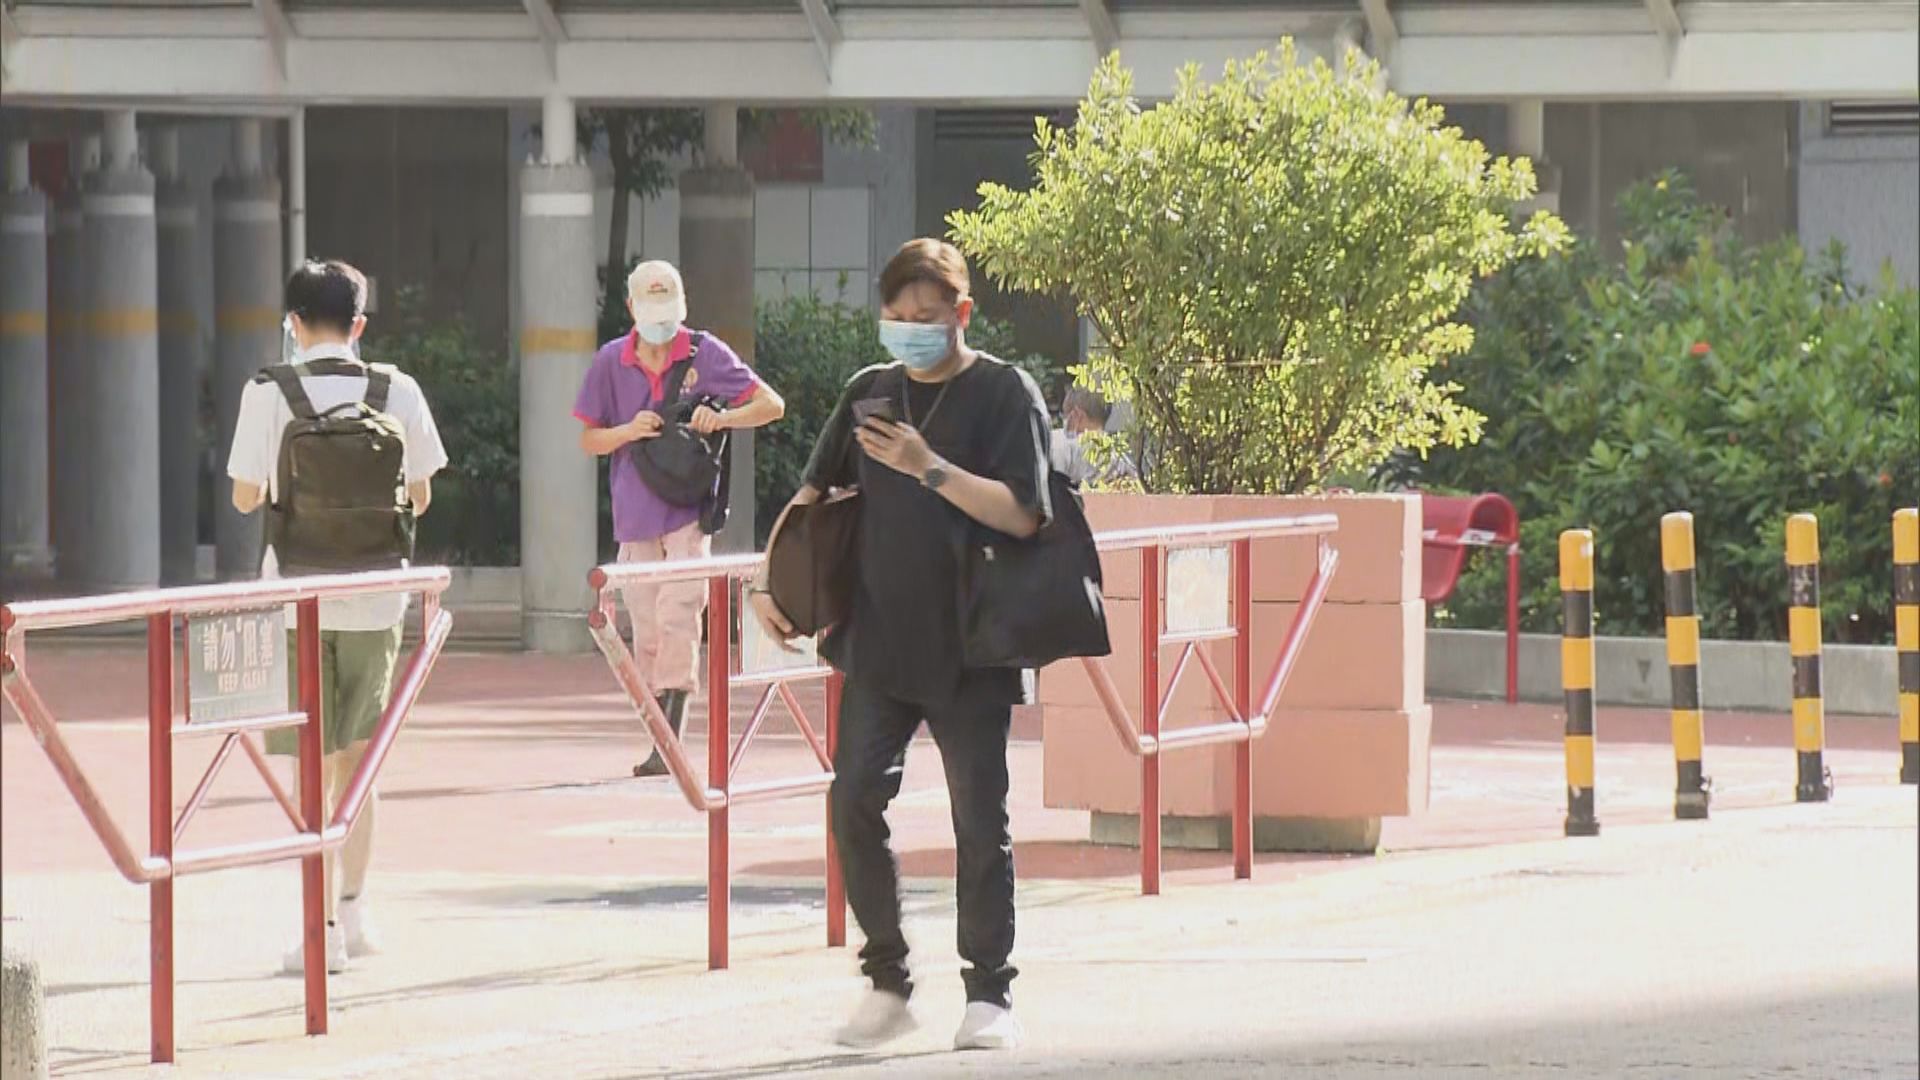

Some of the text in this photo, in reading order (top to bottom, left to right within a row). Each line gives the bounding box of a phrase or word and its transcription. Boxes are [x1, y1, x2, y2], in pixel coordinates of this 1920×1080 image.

[203, 619, 273, 672] 請勿阻塞
[218, 669, 268, 693] KEEP CLEAR
